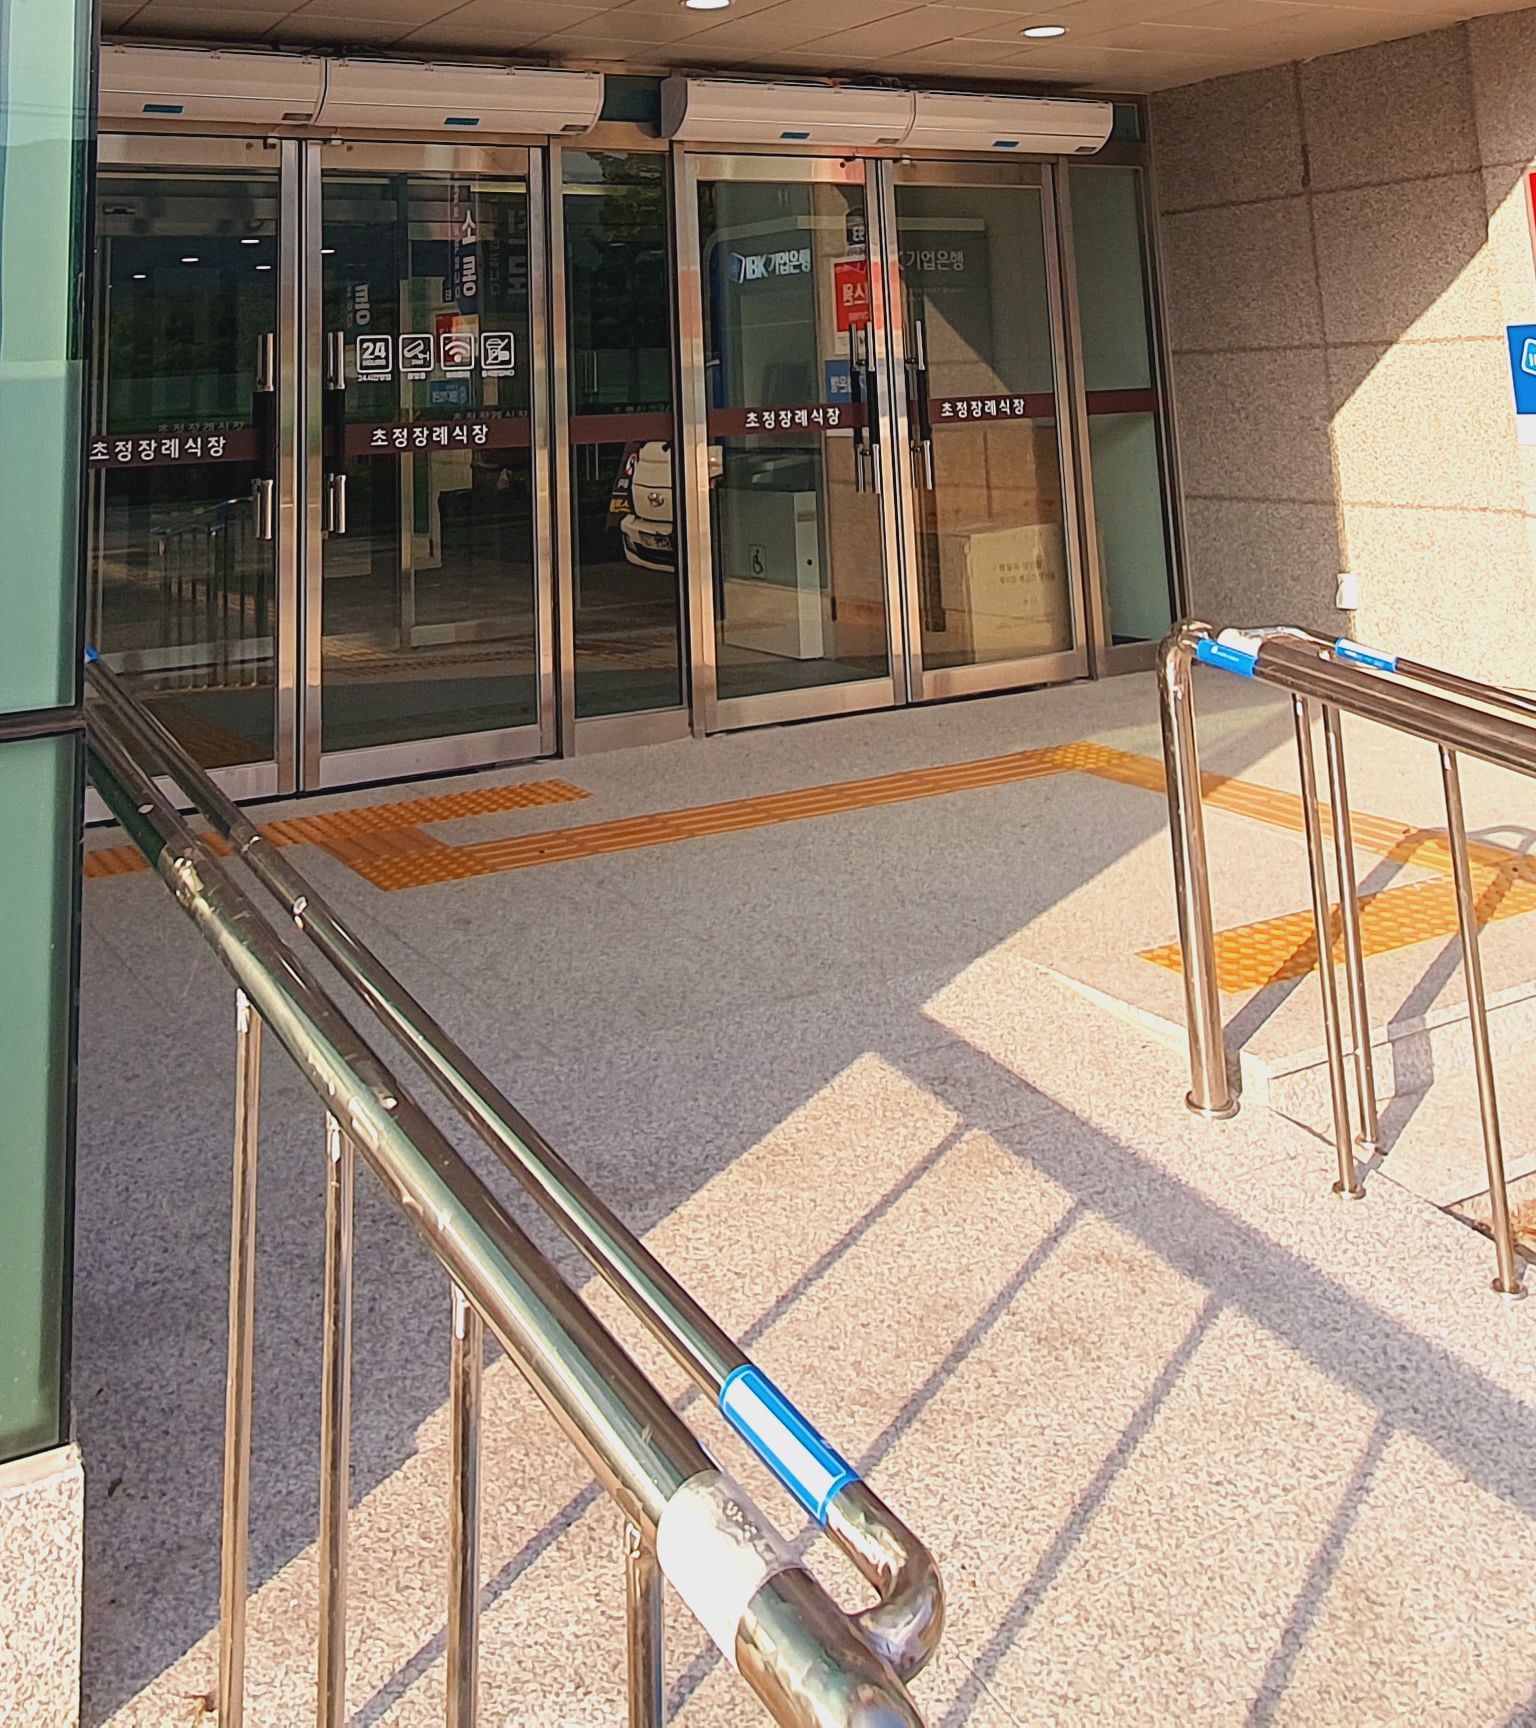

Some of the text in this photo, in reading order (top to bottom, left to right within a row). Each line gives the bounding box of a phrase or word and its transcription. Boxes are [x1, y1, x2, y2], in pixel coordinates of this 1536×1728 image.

[362, 342, 387, 359] 24
[745, 407, 840, 429] 초정장례식장
[941, 398, 1025, 419] 초정장례식장
[370, 424, 489, 448] 초정장례식장
[89, 436, 226, 462] 초정장례식장
